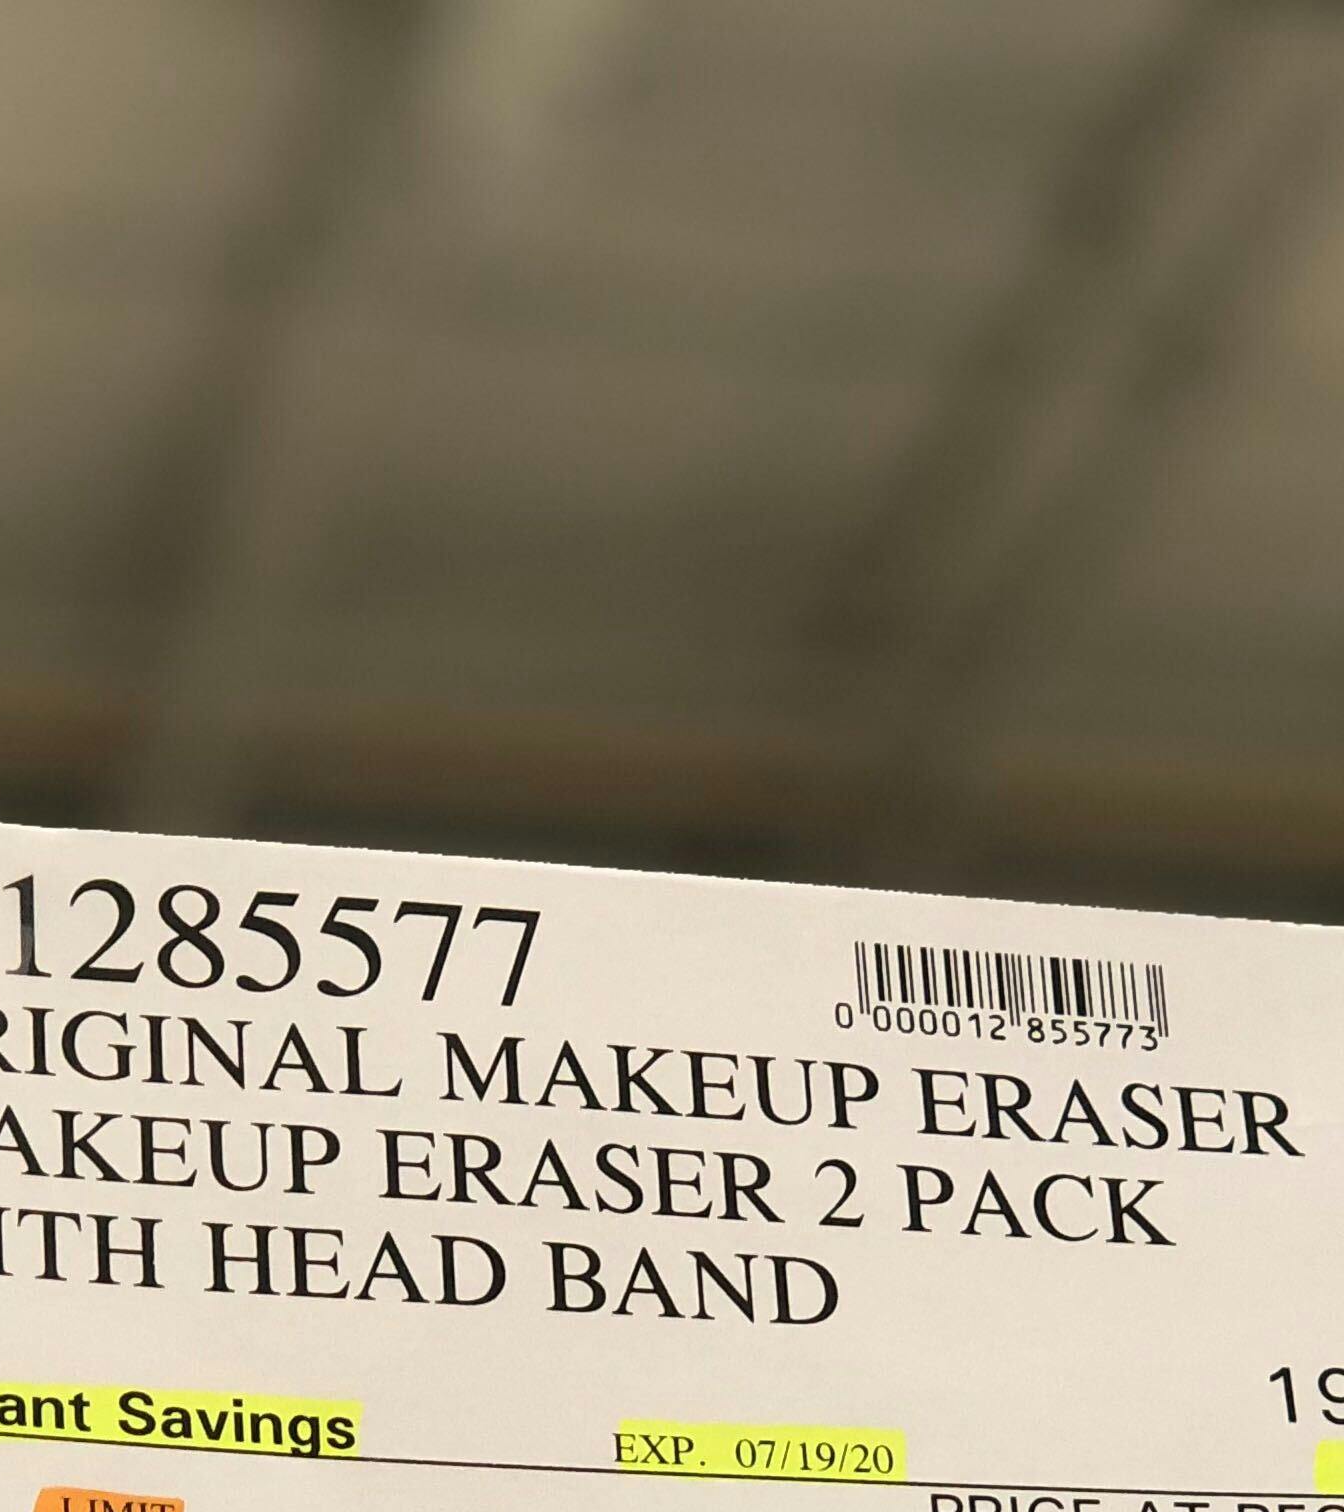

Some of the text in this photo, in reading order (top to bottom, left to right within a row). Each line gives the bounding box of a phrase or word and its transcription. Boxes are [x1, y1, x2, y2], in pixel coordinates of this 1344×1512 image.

[3, 874, 541, 1007] 1285577
[436, 1032, 879, 1129] MAKEUP
[911, 1067, 1306, 1157] ERASER
[376, 1129, 786, 1224] ERASER
[814, 1158, 865, 1228] 2
[897, 1164, 1177, 1247] PACK
[202, 1221, 506, 1306] HEAD
[542, 1241, 839, 1325] BAND
[118, 1390, 356, 1456] Savings
[613, 1432, 894, 1474] EXP. 07/19/20
